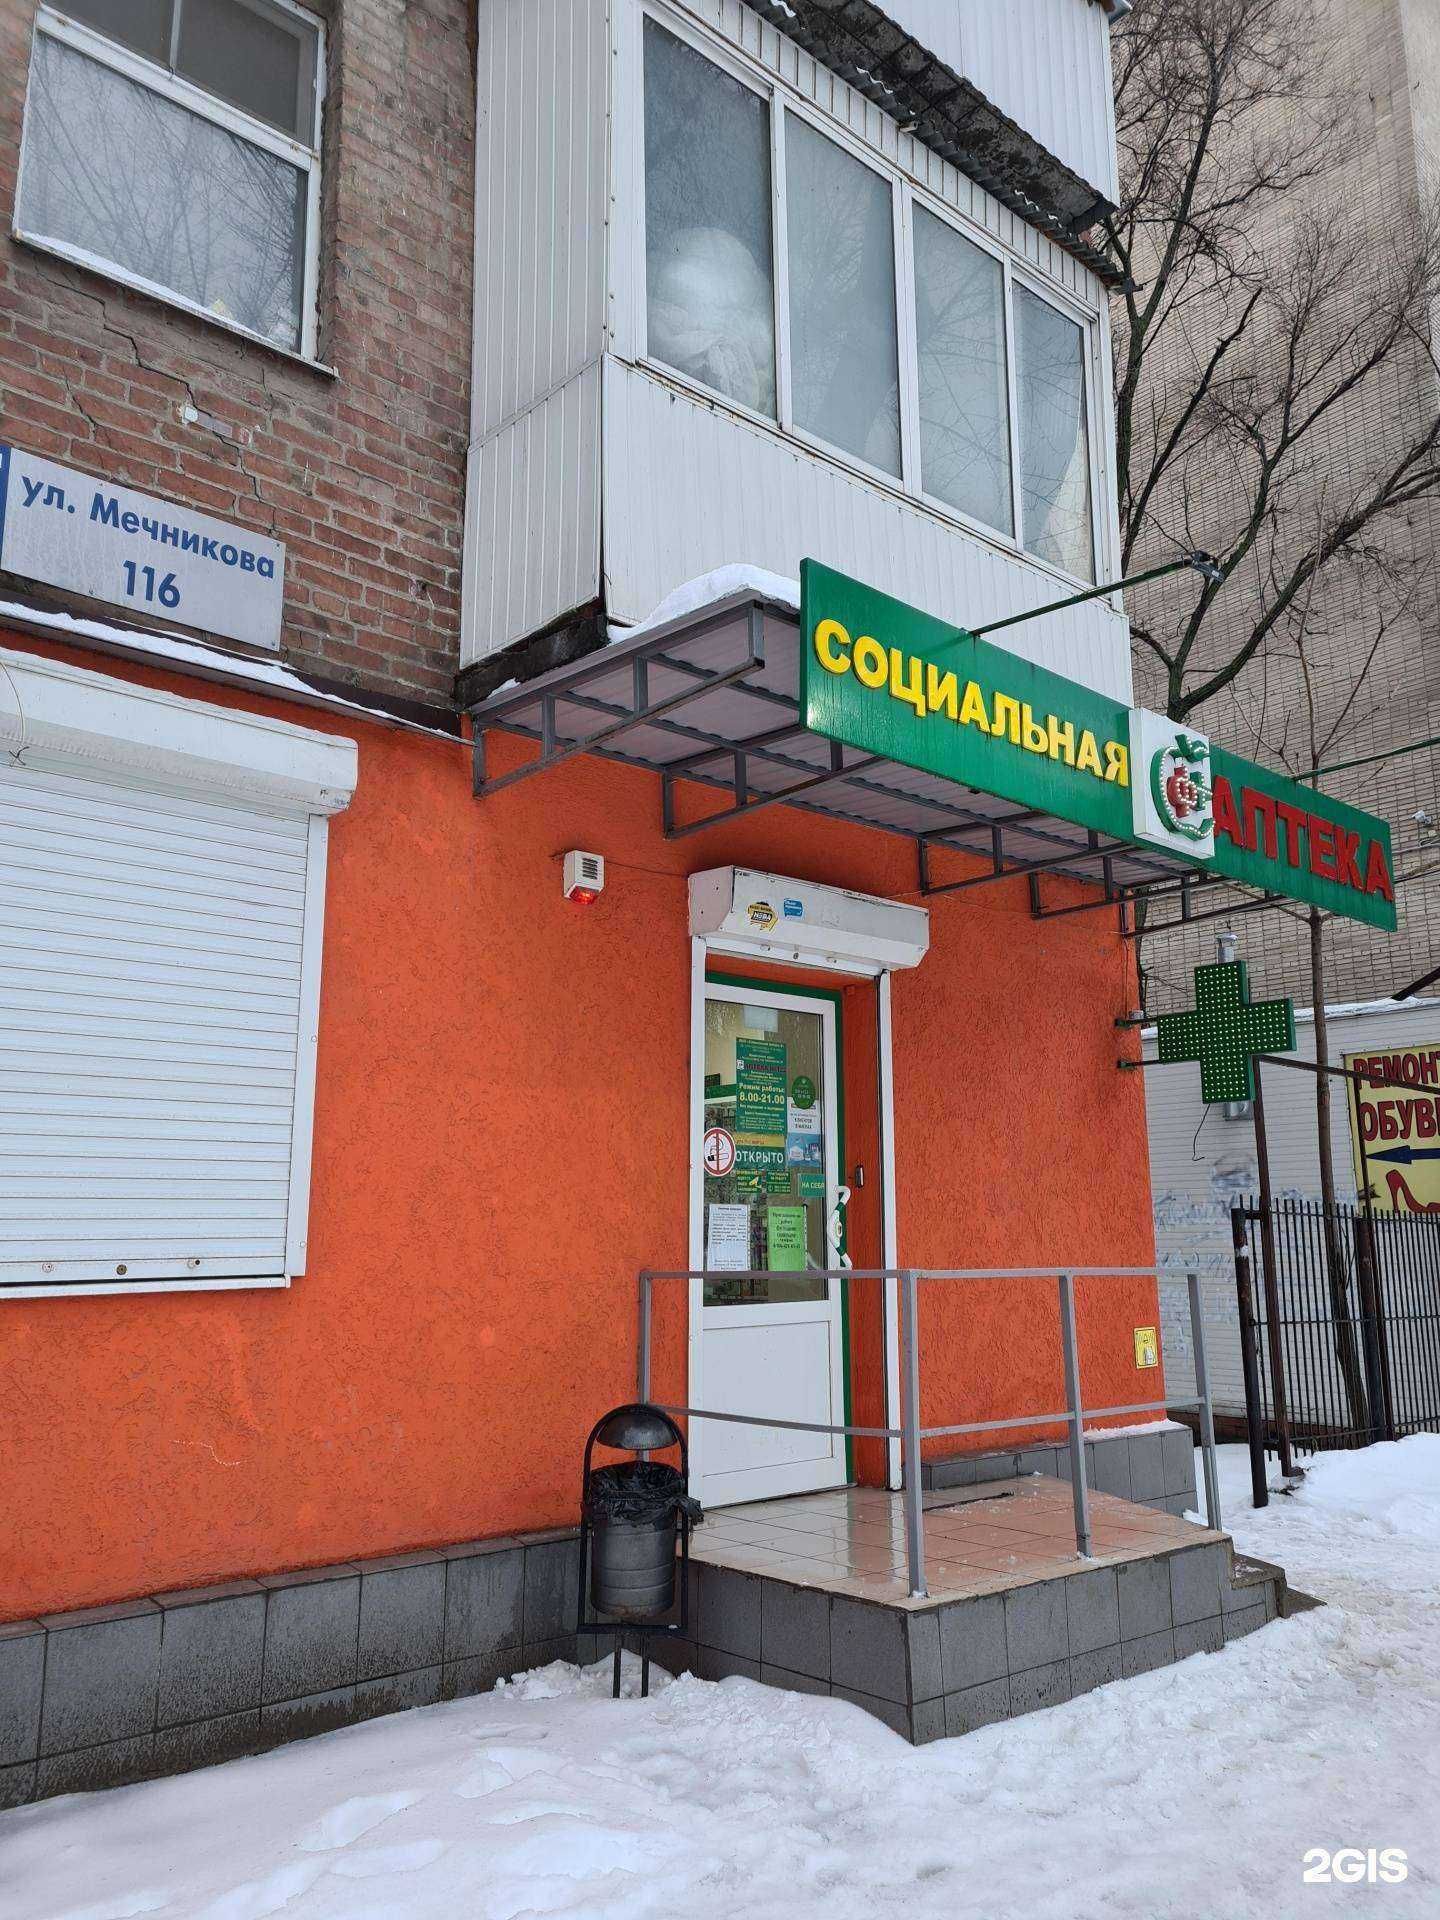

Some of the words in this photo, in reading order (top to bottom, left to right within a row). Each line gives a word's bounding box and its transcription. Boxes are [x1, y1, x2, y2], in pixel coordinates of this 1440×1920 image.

[22, 476, 75, 514] ул.
[90, 493, 274, 579] Мечникова
[123, 560, 181, 608] 116
[814, 618, 1130, 788] СОЦИАЛЬНАЯ
[1214, 774, 1396, 902] АПТЕКА
[1353, 1051, 1440, 1089] РЕМОН
[739, 1091, 785, 1104] 8.00-21.00
[1359, 1097, 1440, 1141] ОБУВ
[735, 1151, 784, 1164] ОТКРЫТО
